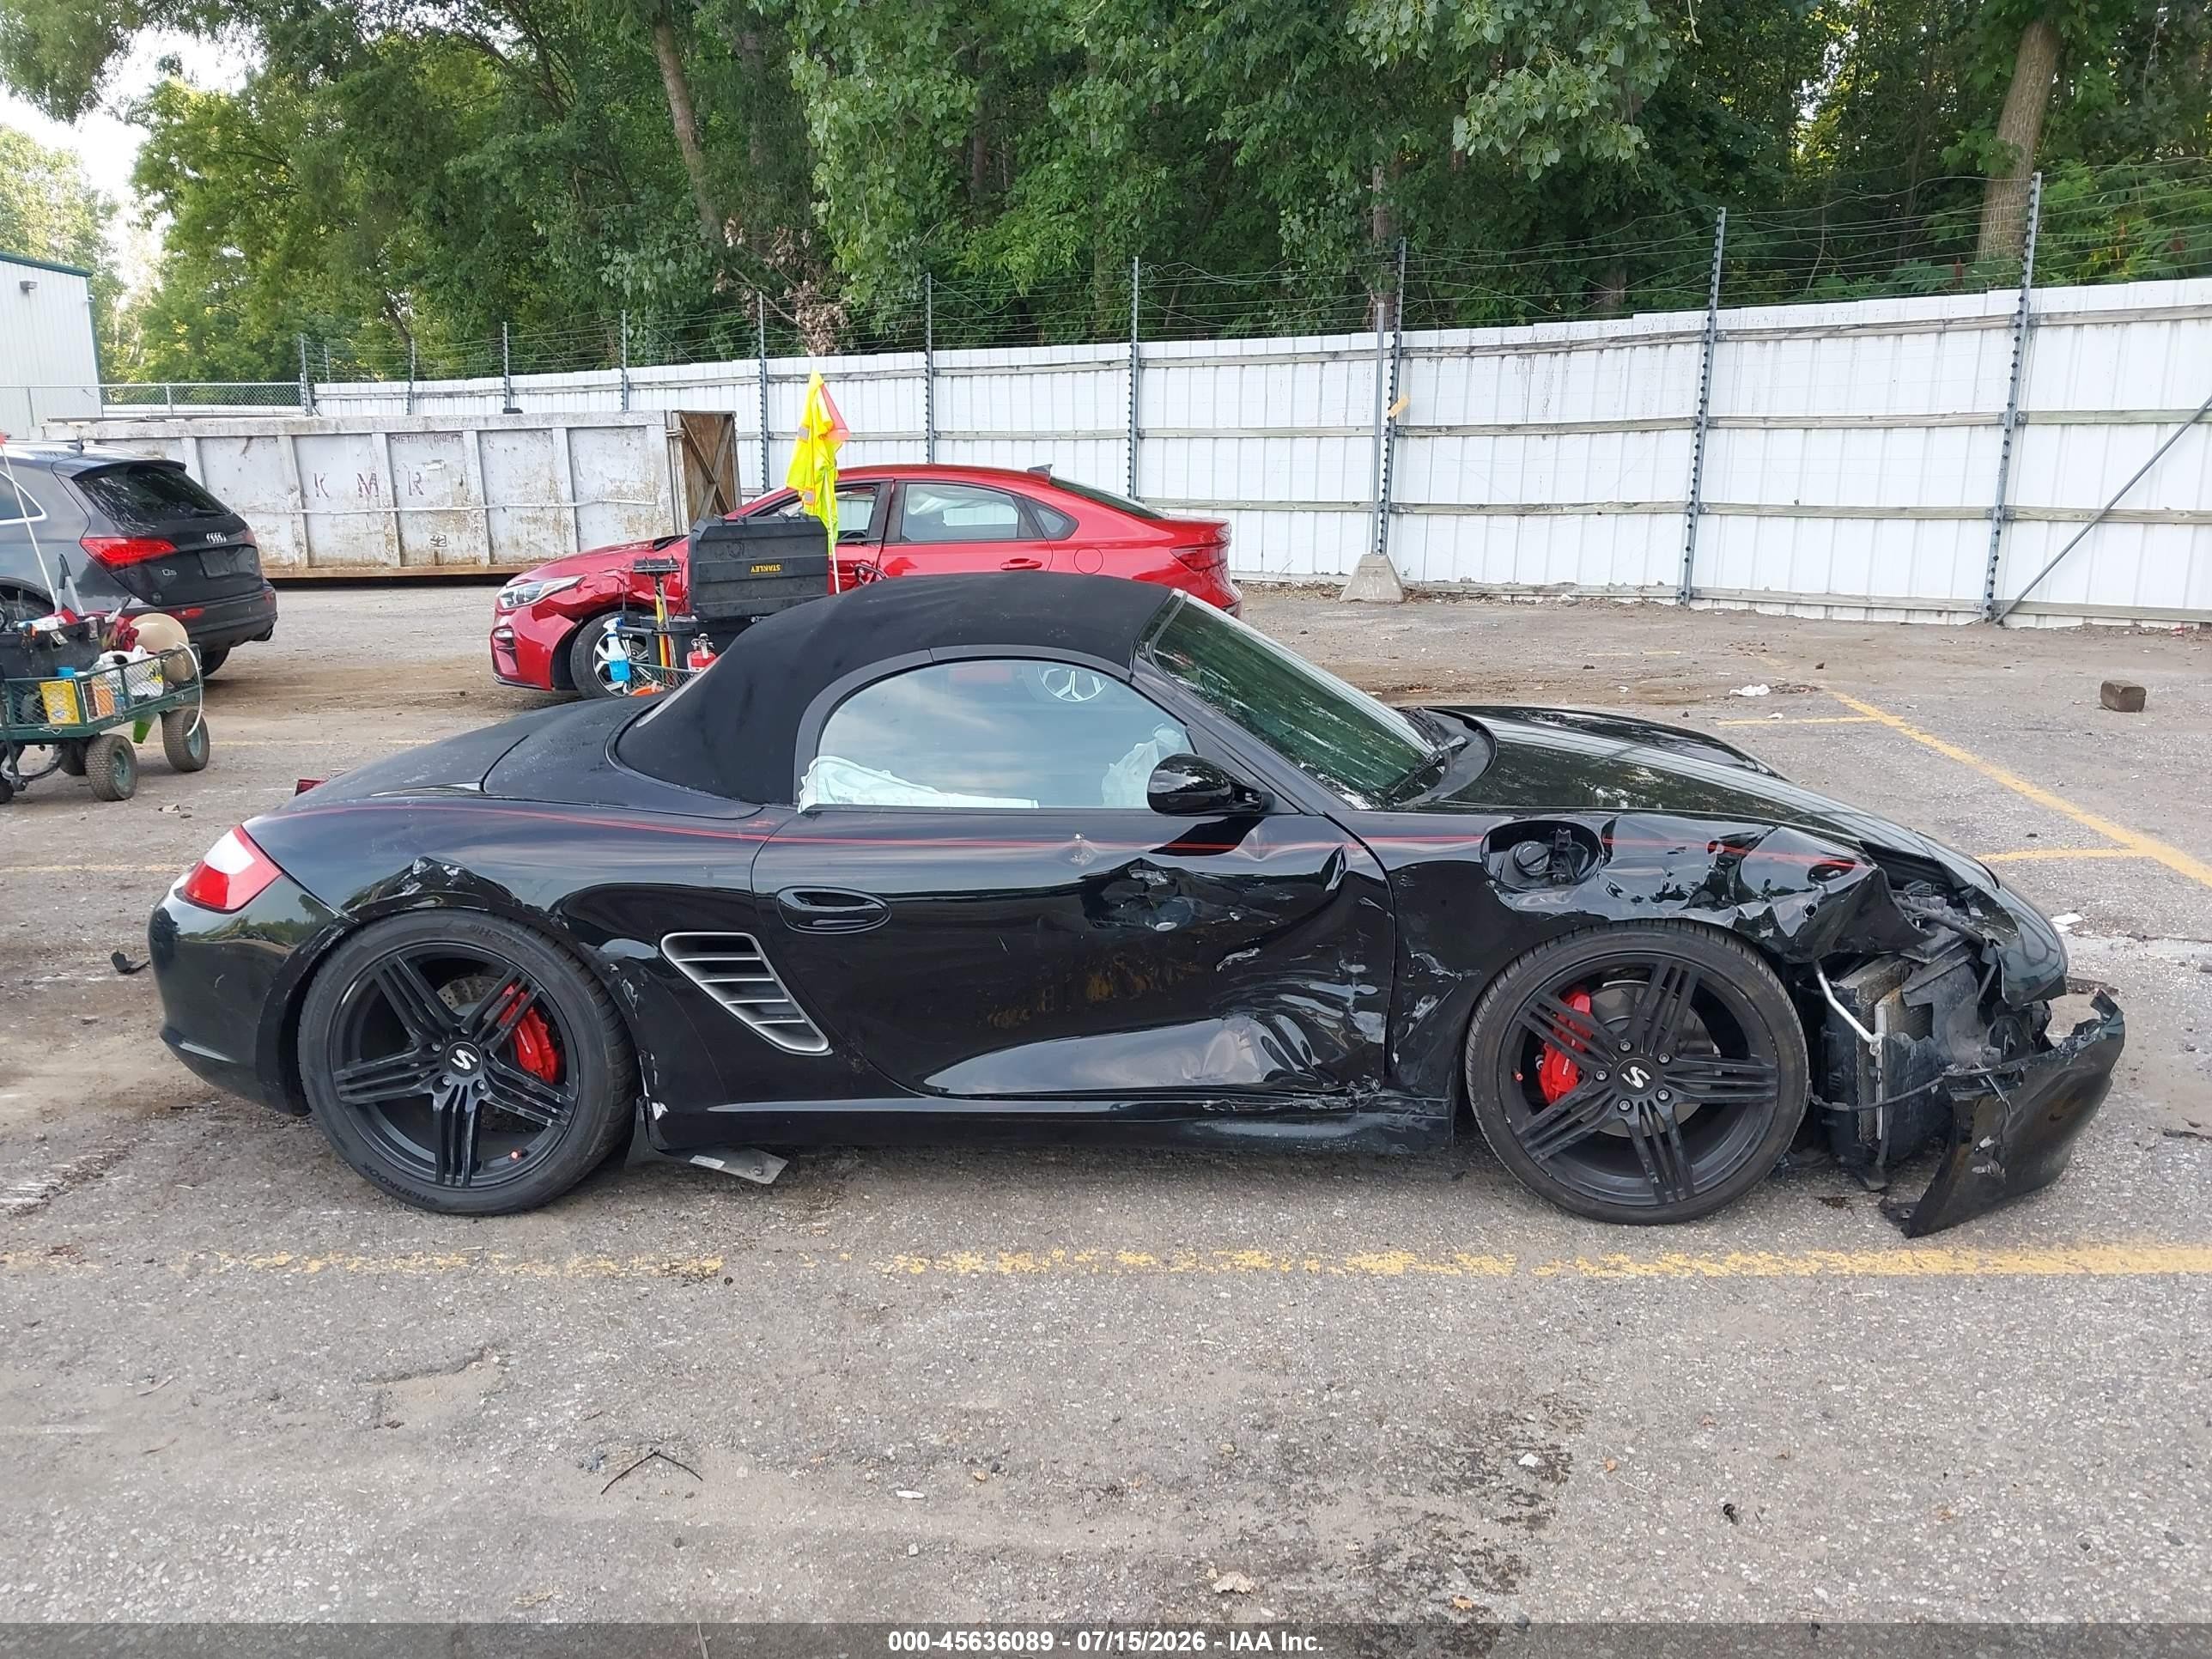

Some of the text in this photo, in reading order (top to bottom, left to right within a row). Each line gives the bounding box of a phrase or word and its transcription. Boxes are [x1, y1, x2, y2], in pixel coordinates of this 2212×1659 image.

[314, 471, 425, 498] K M R
[750, 563, 781, 574] STANLEY
